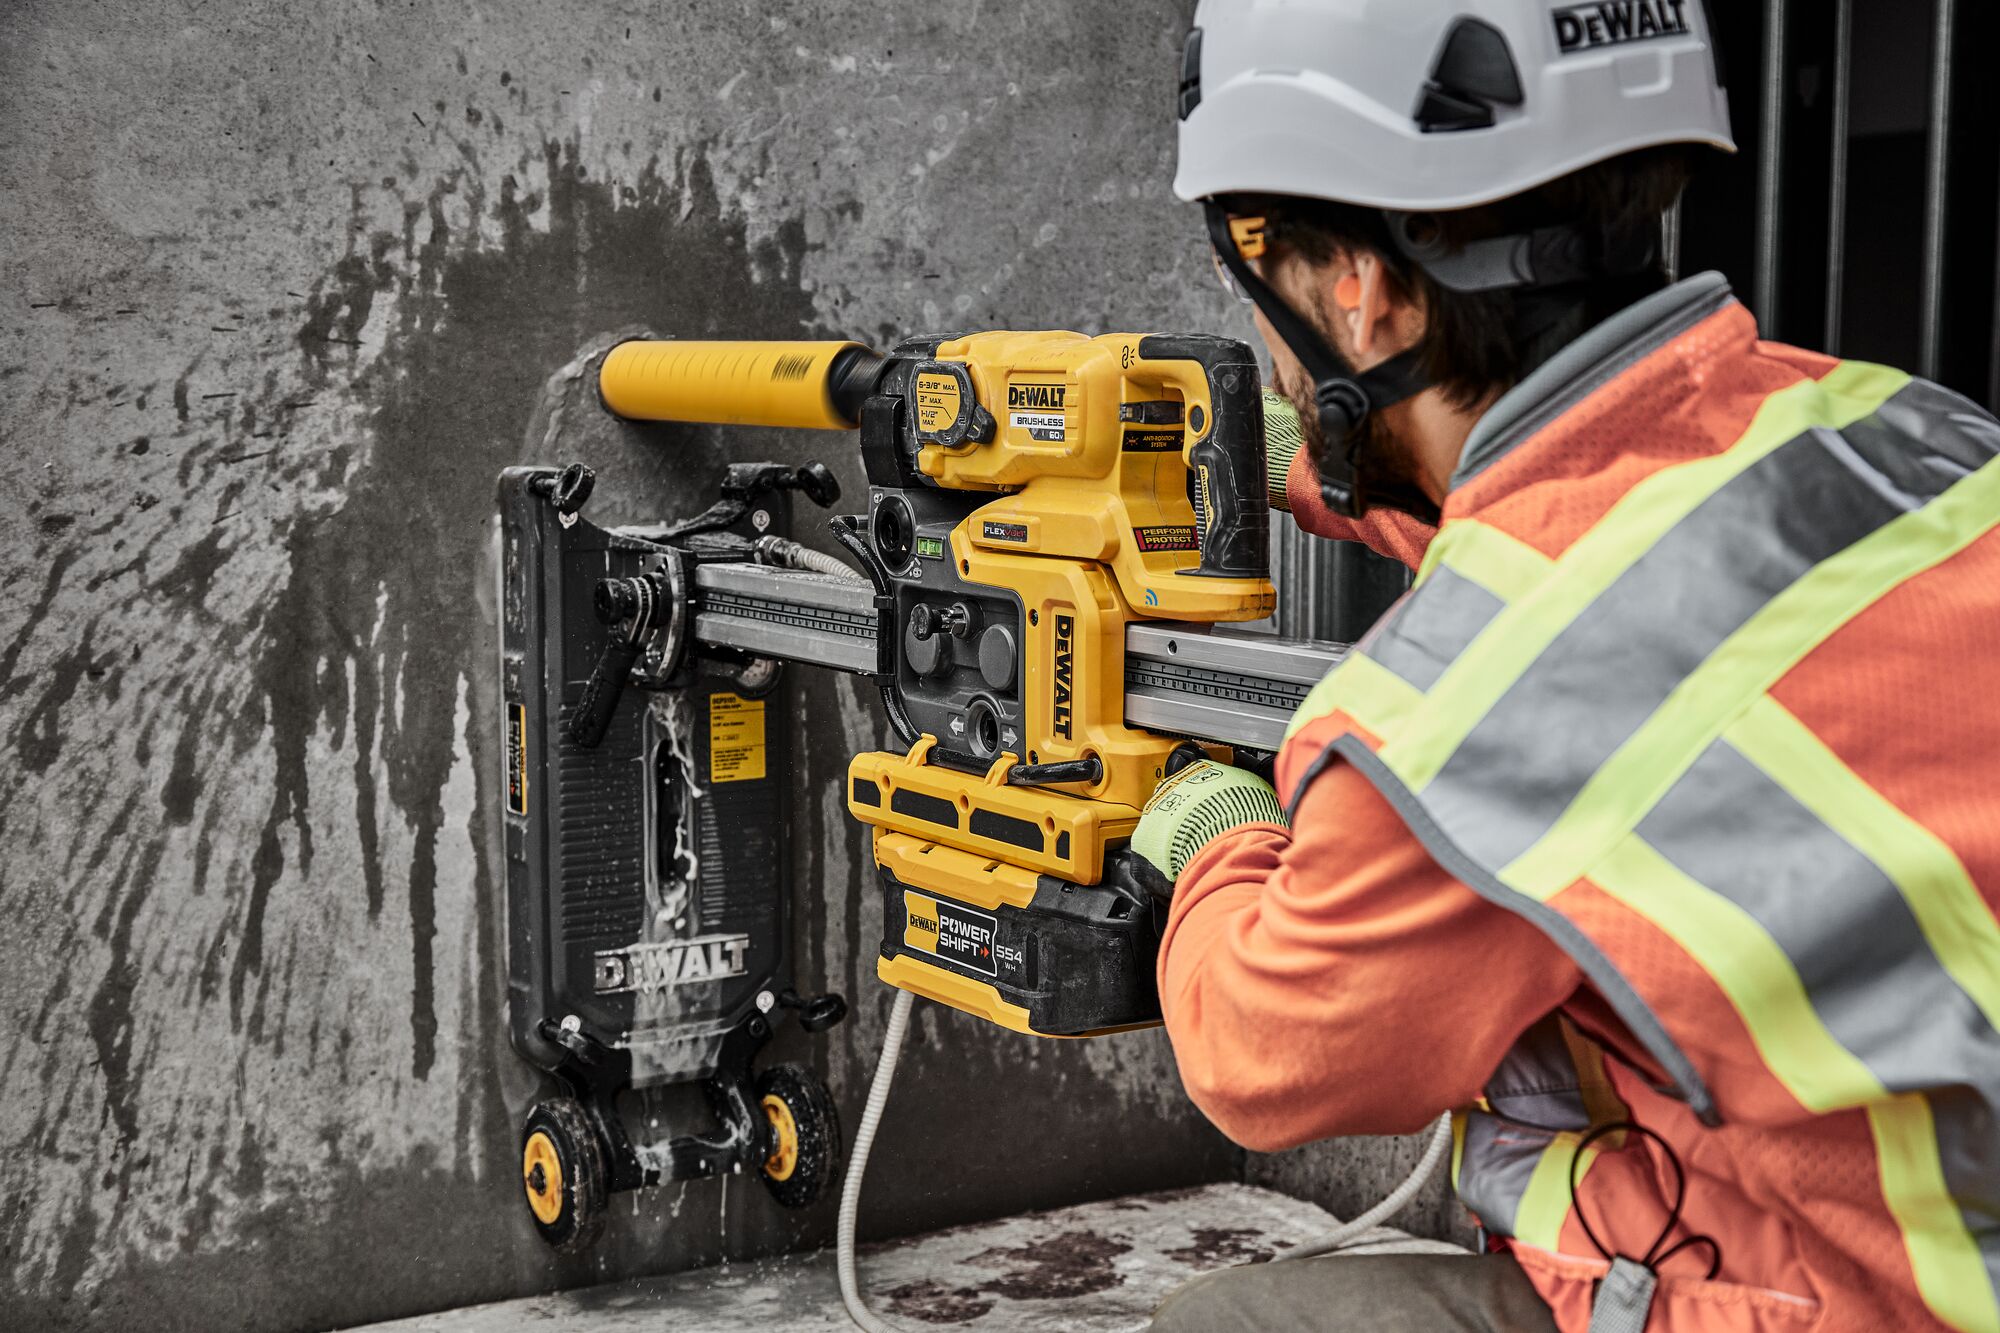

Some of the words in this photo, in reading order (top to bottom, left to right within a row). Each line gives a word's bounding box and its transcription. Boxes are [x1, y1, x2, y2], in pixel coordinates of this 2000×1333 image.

[1017, 416, 1064, 427] BRUSHLESS
[984, 526, 1025, 538] FLEXVOLT
[1142, 528, 1192, 536] PERFORM
[940, 914, 990, 945] POWER
[939, 932, 980, 957] SHIFT
[996, 944, 1023, 964] 554
